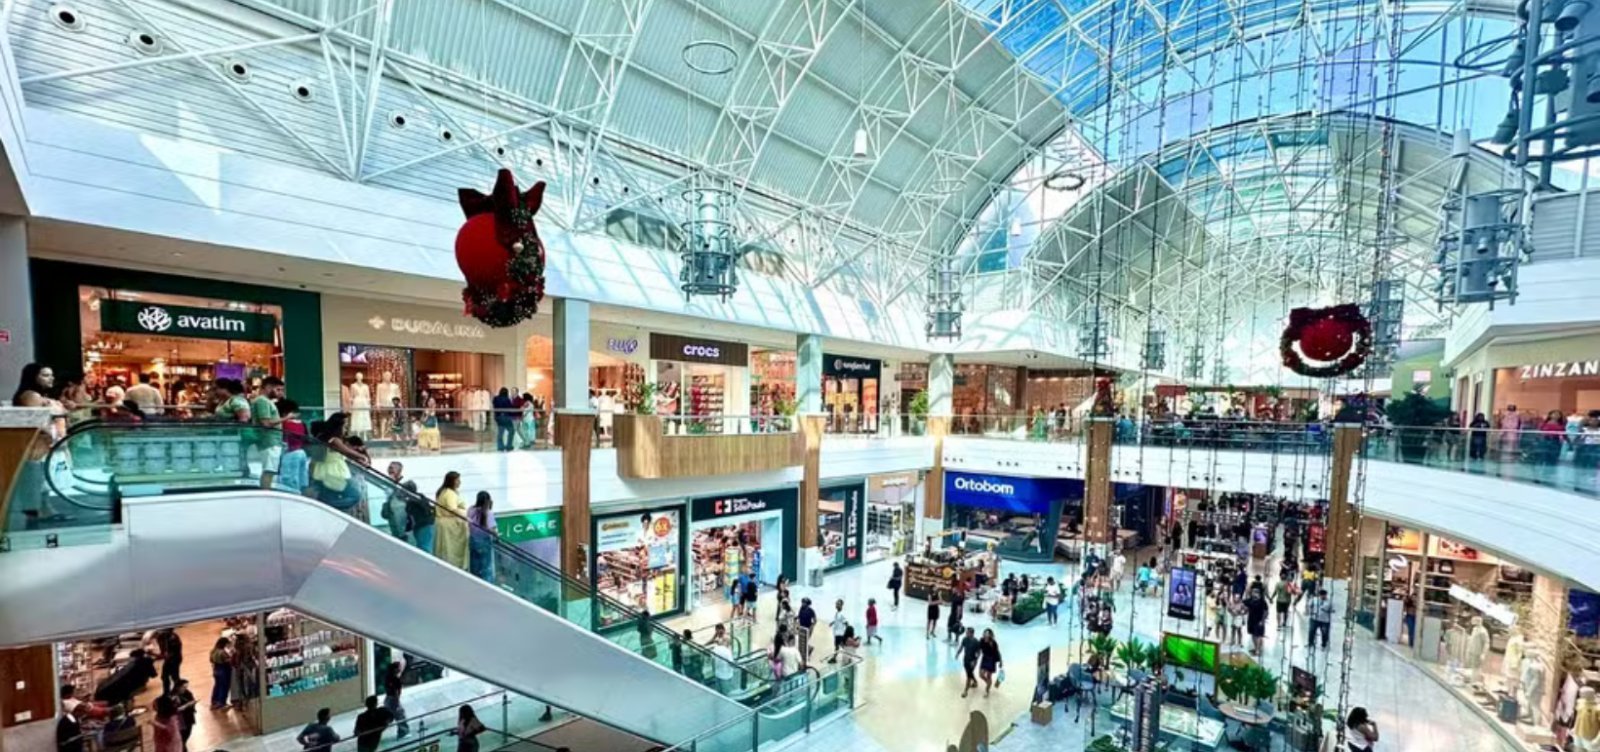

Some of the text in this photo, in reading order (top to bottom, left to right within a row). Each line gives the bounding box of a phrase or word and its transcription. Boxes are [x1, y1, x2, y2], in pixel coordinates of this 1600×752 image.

[177, 315, 246, 332] avatim
[683, 344, 720, 357] crocs
[1521, 360, 1599, 378] ZINZAN
[954, 477, 1014, 495] Ortobom
[513, 520, 557, 533] CARE
